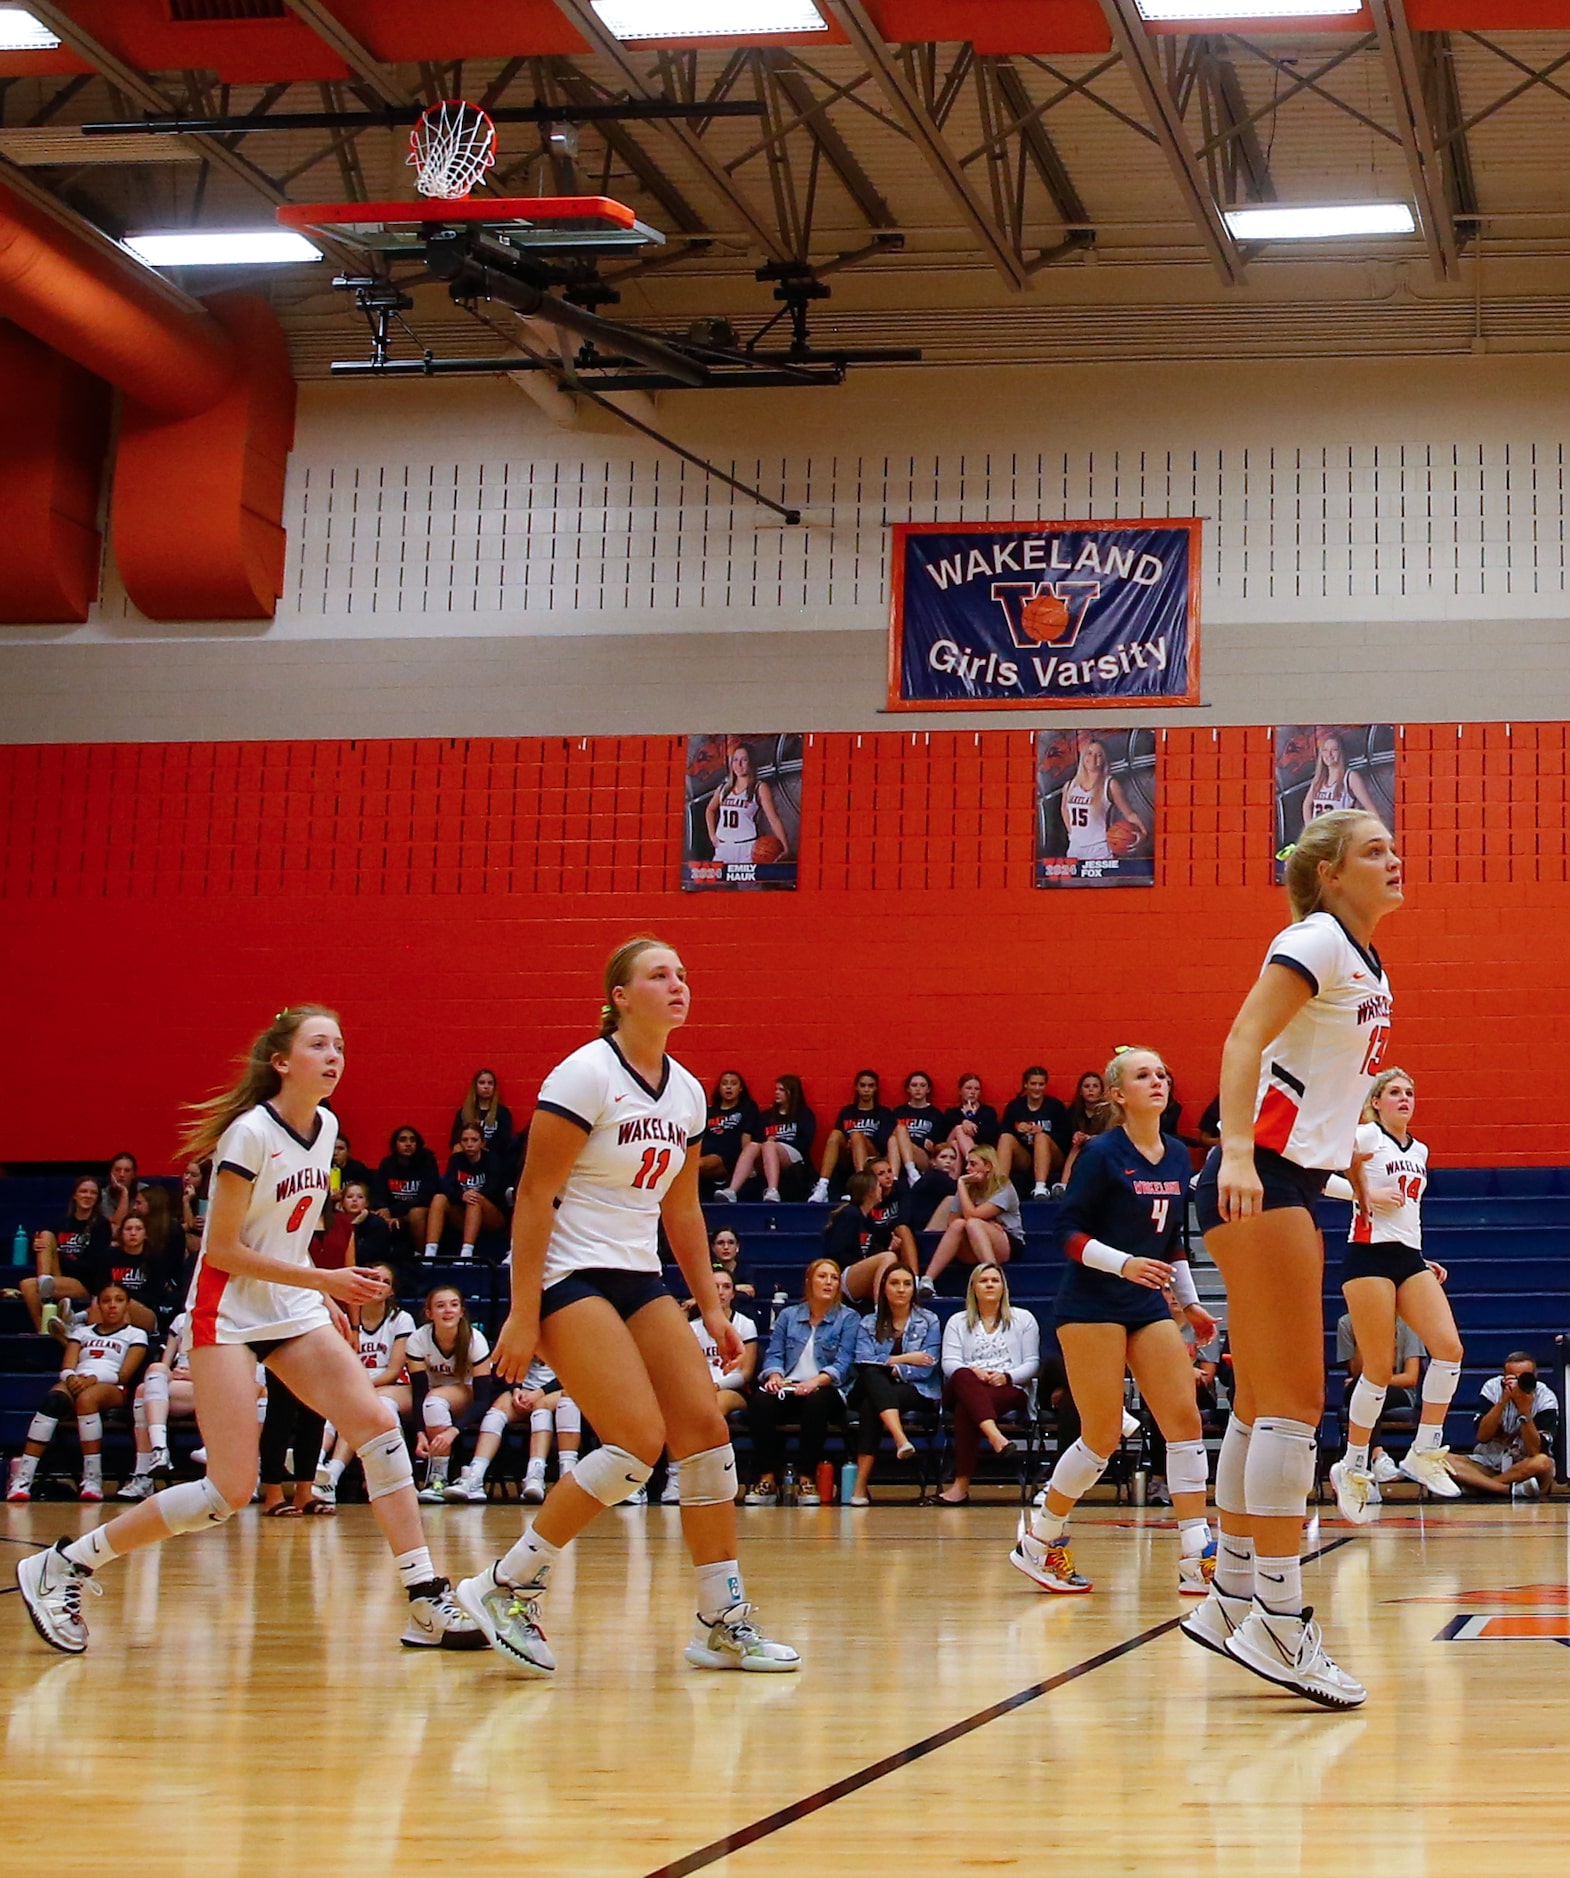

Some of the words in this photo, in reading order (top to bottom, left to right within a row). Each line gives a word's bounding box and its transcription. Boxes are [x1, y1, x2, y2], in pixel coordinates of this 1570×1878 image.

[926, 539, 1164, 591] WAKELAND
[928, 638, 1019, 687] Girls
[1032, 635, 1168, 688] Varsity
[723, 809, 739, 829] 10
[1071, 807, 1088, 828] 15
[727, 863, 758, 873] EMILY
[1080, 868, 1103, 878] FOX
[1081, 859, 1120, 869] JESSIE
[726, 872, 757, 881] HAUK
[630, 1146, 672, 1190] 11
[1397, 1174, 1422, 1204] 14
[1150, 1198, 1170, 1234] 4
